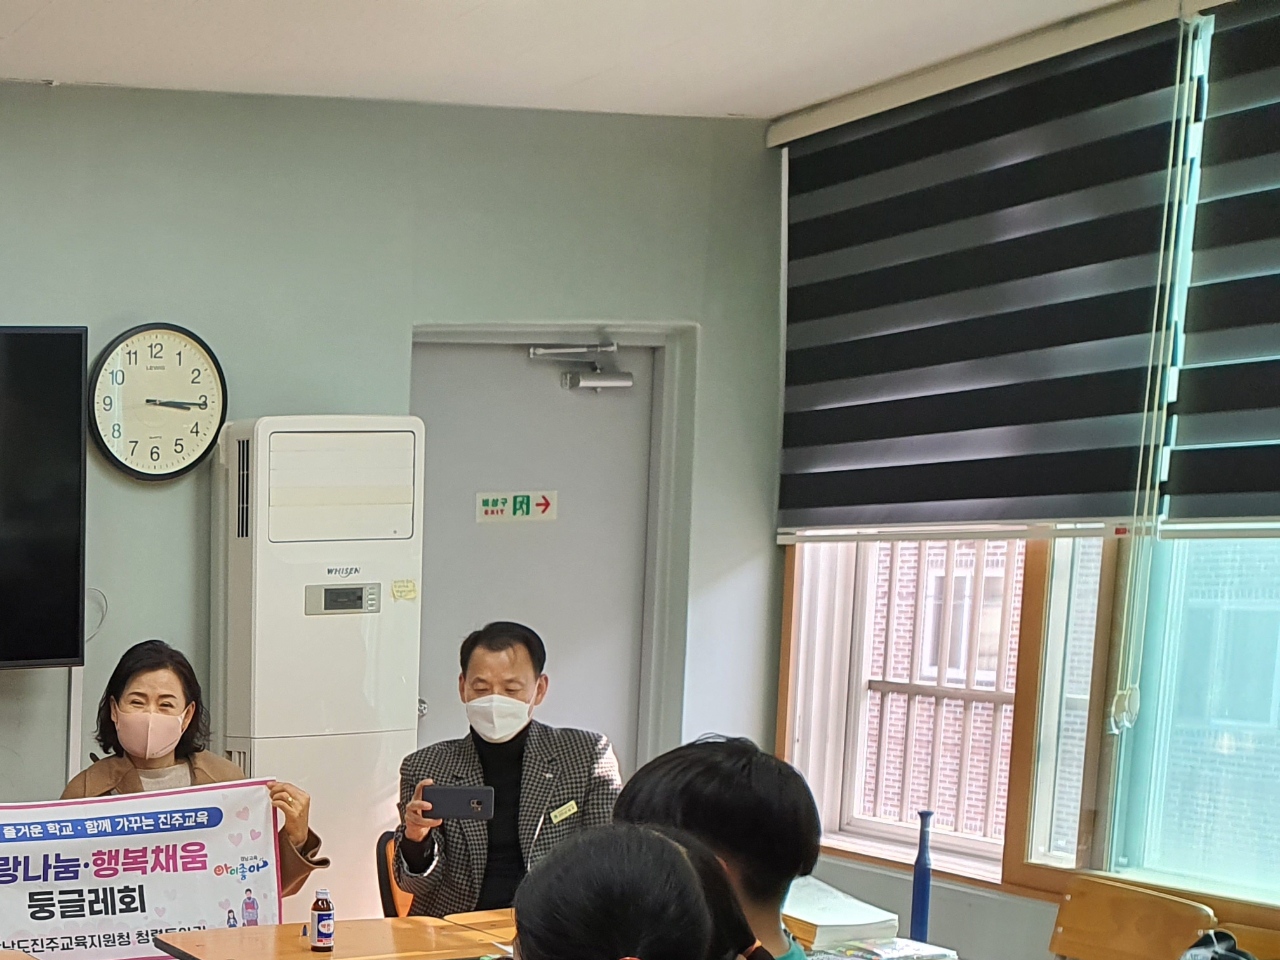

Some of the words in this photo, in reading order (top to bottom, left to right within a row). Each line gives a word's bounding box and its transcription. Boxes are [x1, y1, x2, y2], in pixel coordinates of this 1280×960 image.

[125, 350, 138, 365] 11
[147, 343, 163, 359] 12
[176, 351, 182, 366] 1
[109, 369, 125, 385] 10
[191, 368, 201, 384] 2
[103, 396, 113, 411] 9
[198, 395, 208, 410] 3
[112, 423, 121, 439] 8
[190, 422, 200, 437] 4
[128, 440, 138, 456] 7
[150, 446, 160, 461] 6
[174, 438, 184, 454] 5
[327, 567, 361, 577] WHISEN
[3, 824, 44, 839] 즐거운
[46, 821, 74, 837] 학교
[84, 819, 112, 835] 함께
[116, 815, 155, 832] 가꾸는
[158, 811, 209, 829] 진주교육
[27, 884, 147, 921] 둥글레회
